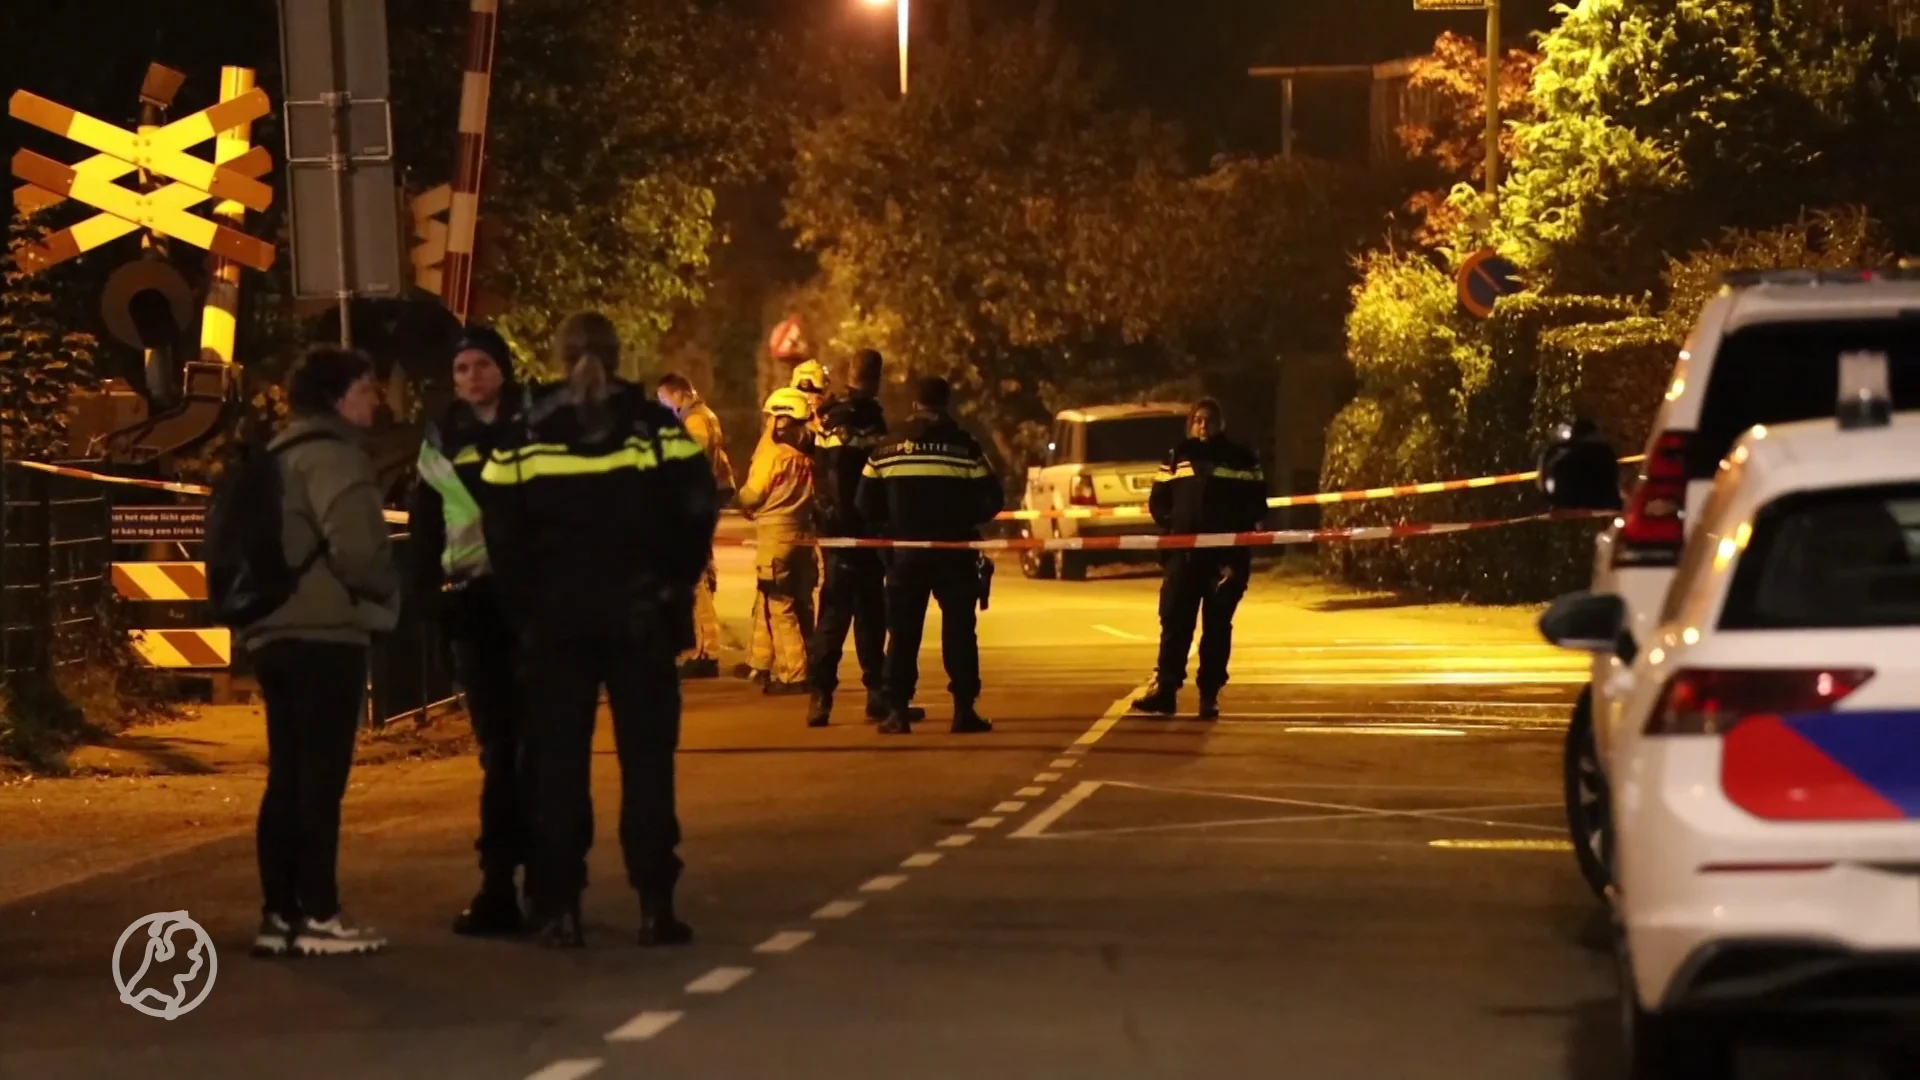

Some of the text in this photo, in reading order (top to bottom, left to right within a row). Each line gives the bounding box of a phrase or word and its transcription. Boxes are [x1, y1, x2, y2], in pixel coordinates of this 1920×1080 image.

[124, 513, 138, 521] het
[140, 513, 158, 521] rode
[160, 512, 178, 521] licht
[121, 526, 136, 535] kan
[138, 527, 154, 537] nog
[173, 526, 193, 535] trein
